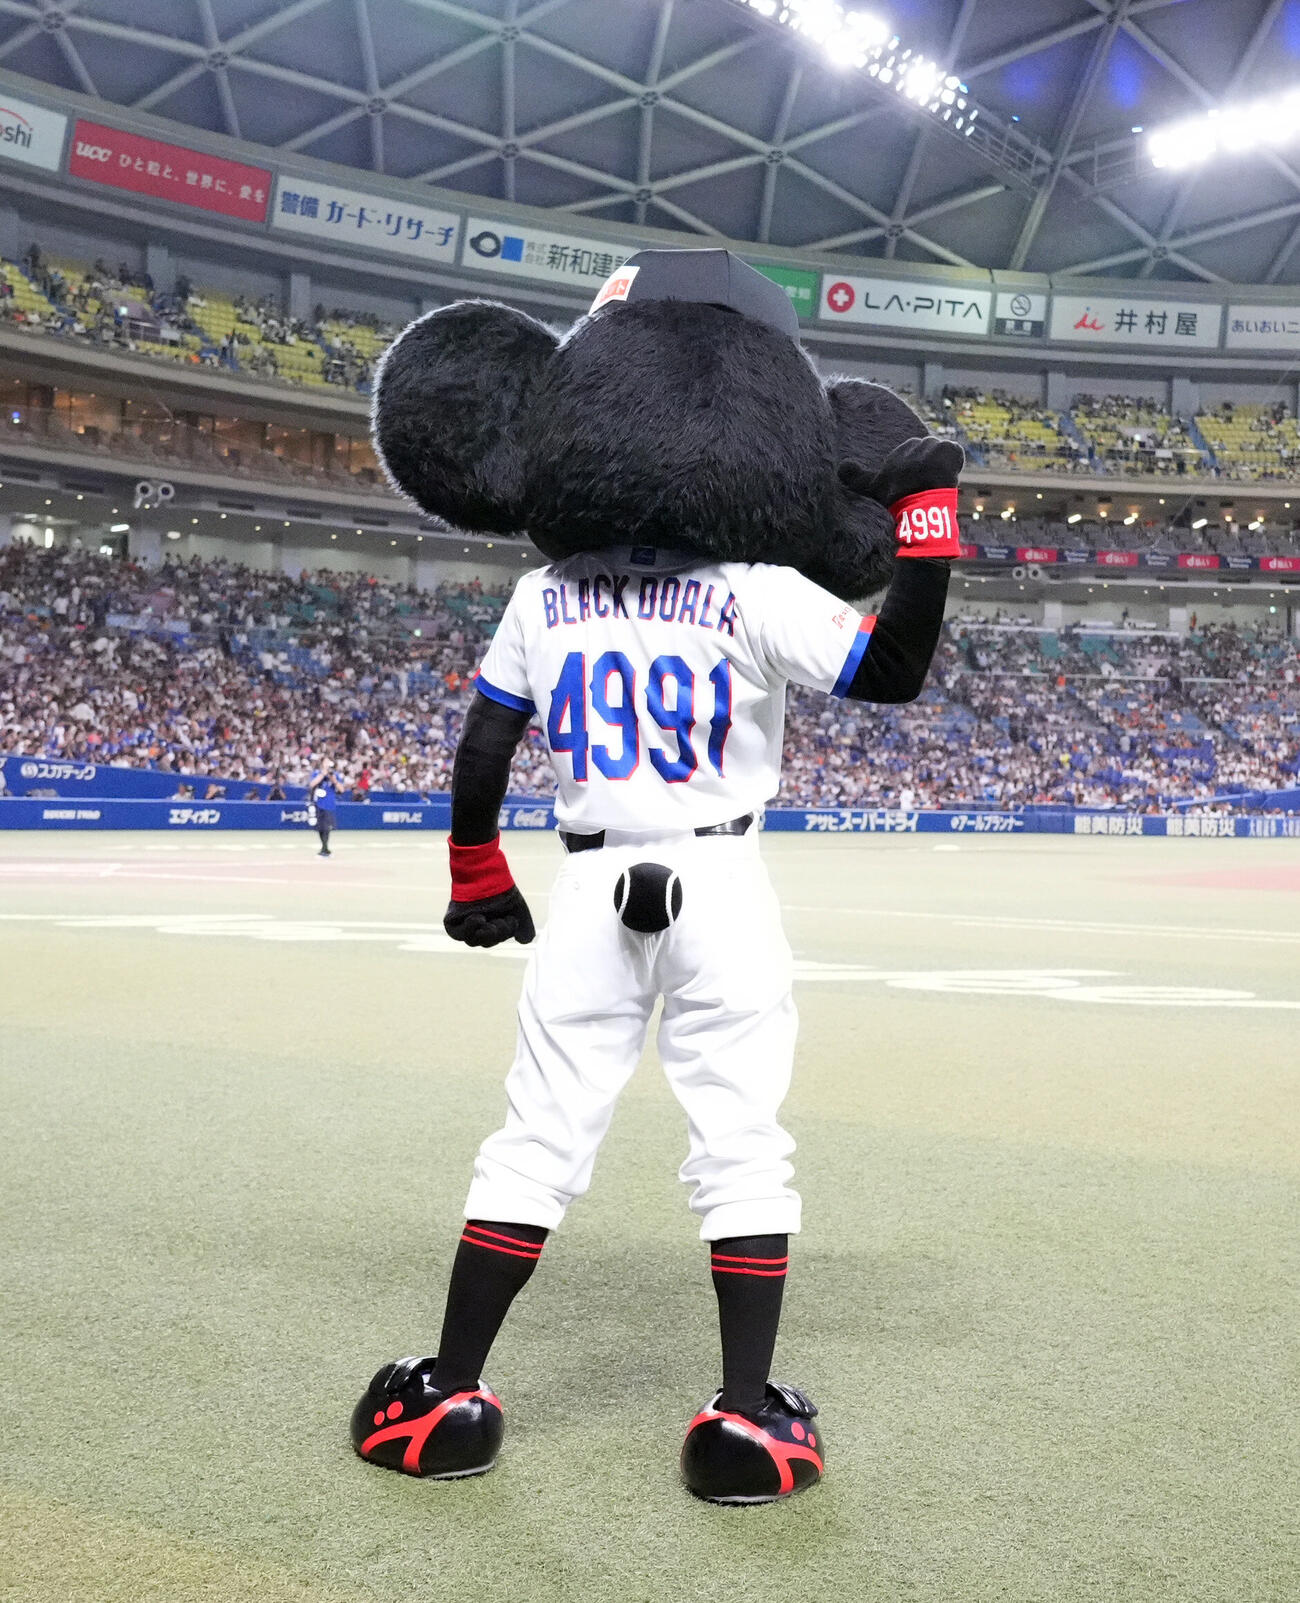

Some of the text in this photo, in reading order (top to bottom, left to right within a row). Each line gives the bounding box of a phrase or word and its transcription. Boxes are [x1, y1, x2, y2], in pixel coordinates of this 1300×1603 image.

[0, 123, 34, 149] shi
[75, 141, 113, 163] UCC
[281, 191, 320, 218] 警備
[1114, 308, 1198, 337] 井村屋
[898, 506, 953, 544] 4991
[542, 574, 738, 637] BLACK DOALA
[547, 651, 733, 784] 4991
[168, 808, 221, 824] エディオン
[805, 811, 919, 831] アサヒスーパードライ
